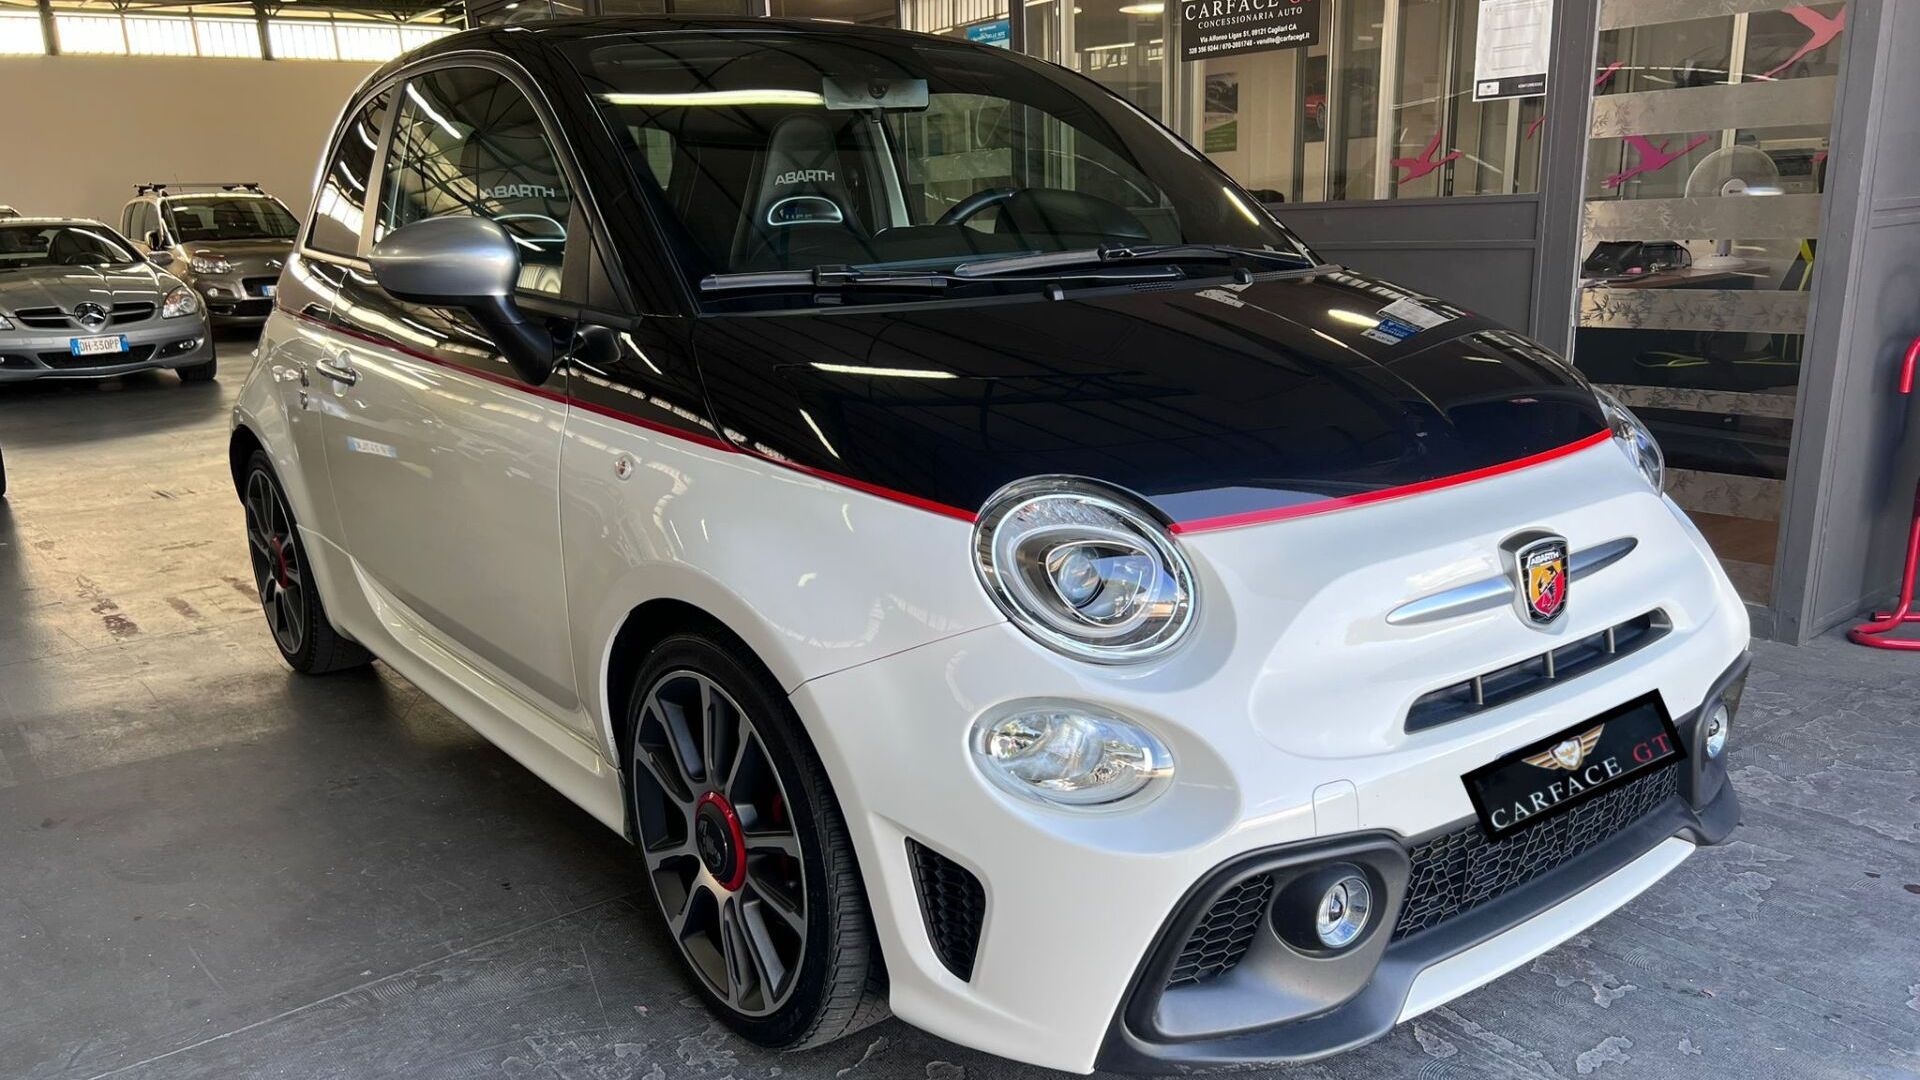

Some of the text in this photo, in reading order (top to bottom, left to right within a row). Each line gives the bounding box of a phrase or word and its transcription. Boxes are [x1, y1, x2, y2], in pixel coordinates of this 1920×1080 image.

[1198, 6, 1303, 29] CONCESSIONARIA AUTO
[1267, 24, 1288, 34] Cagliari
[1288, 23, 1297, 31] CA
[774, 169, 835, 186] ABARTH
[484, 184, 556, 198] ABARTH
[1530, 551, 1559, 565] ABARTH
